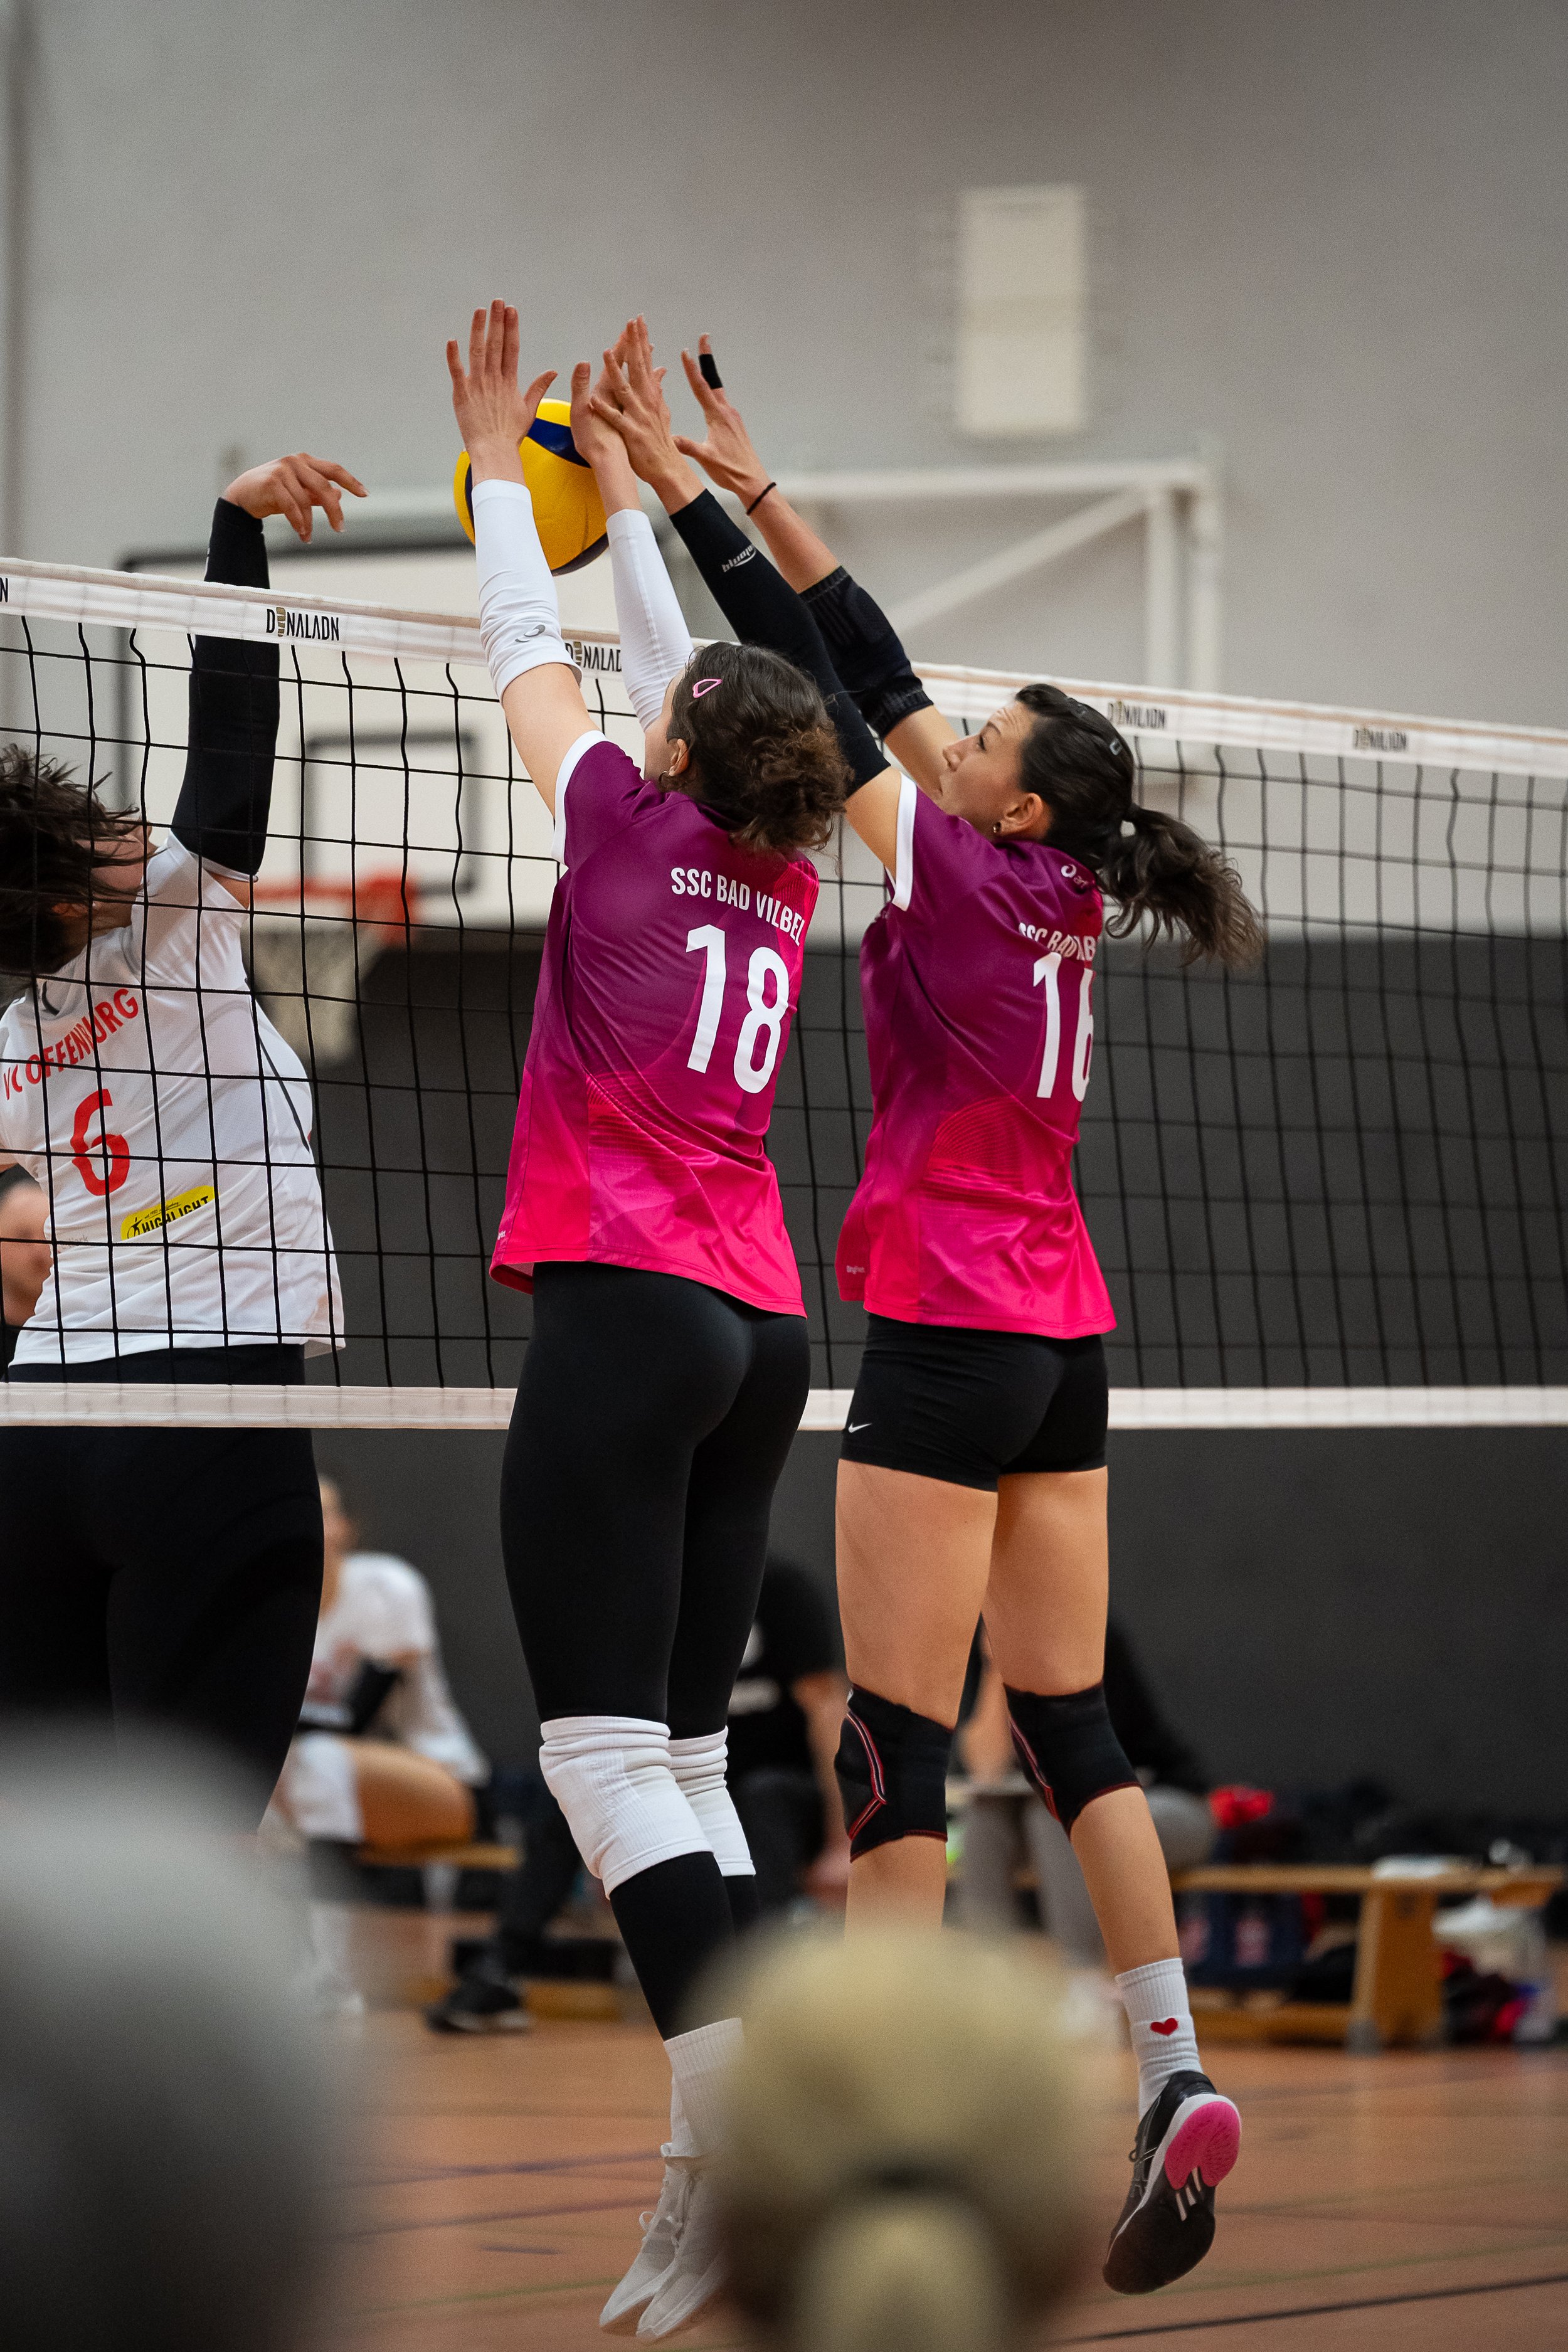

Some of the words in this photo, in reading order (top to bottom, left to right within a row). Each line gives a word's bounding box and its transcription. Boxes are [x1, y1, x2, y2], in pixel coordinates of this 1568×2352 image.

[670, 867, 711, 898] SSC
[717, 874, 750, 911] BAD
[756, 891, 805, 946] VILBEL
[686, 924, 788, 1093] 18
[3, 1064, 23, 1101] VC
[70, 1089, 130, 1196] 6
